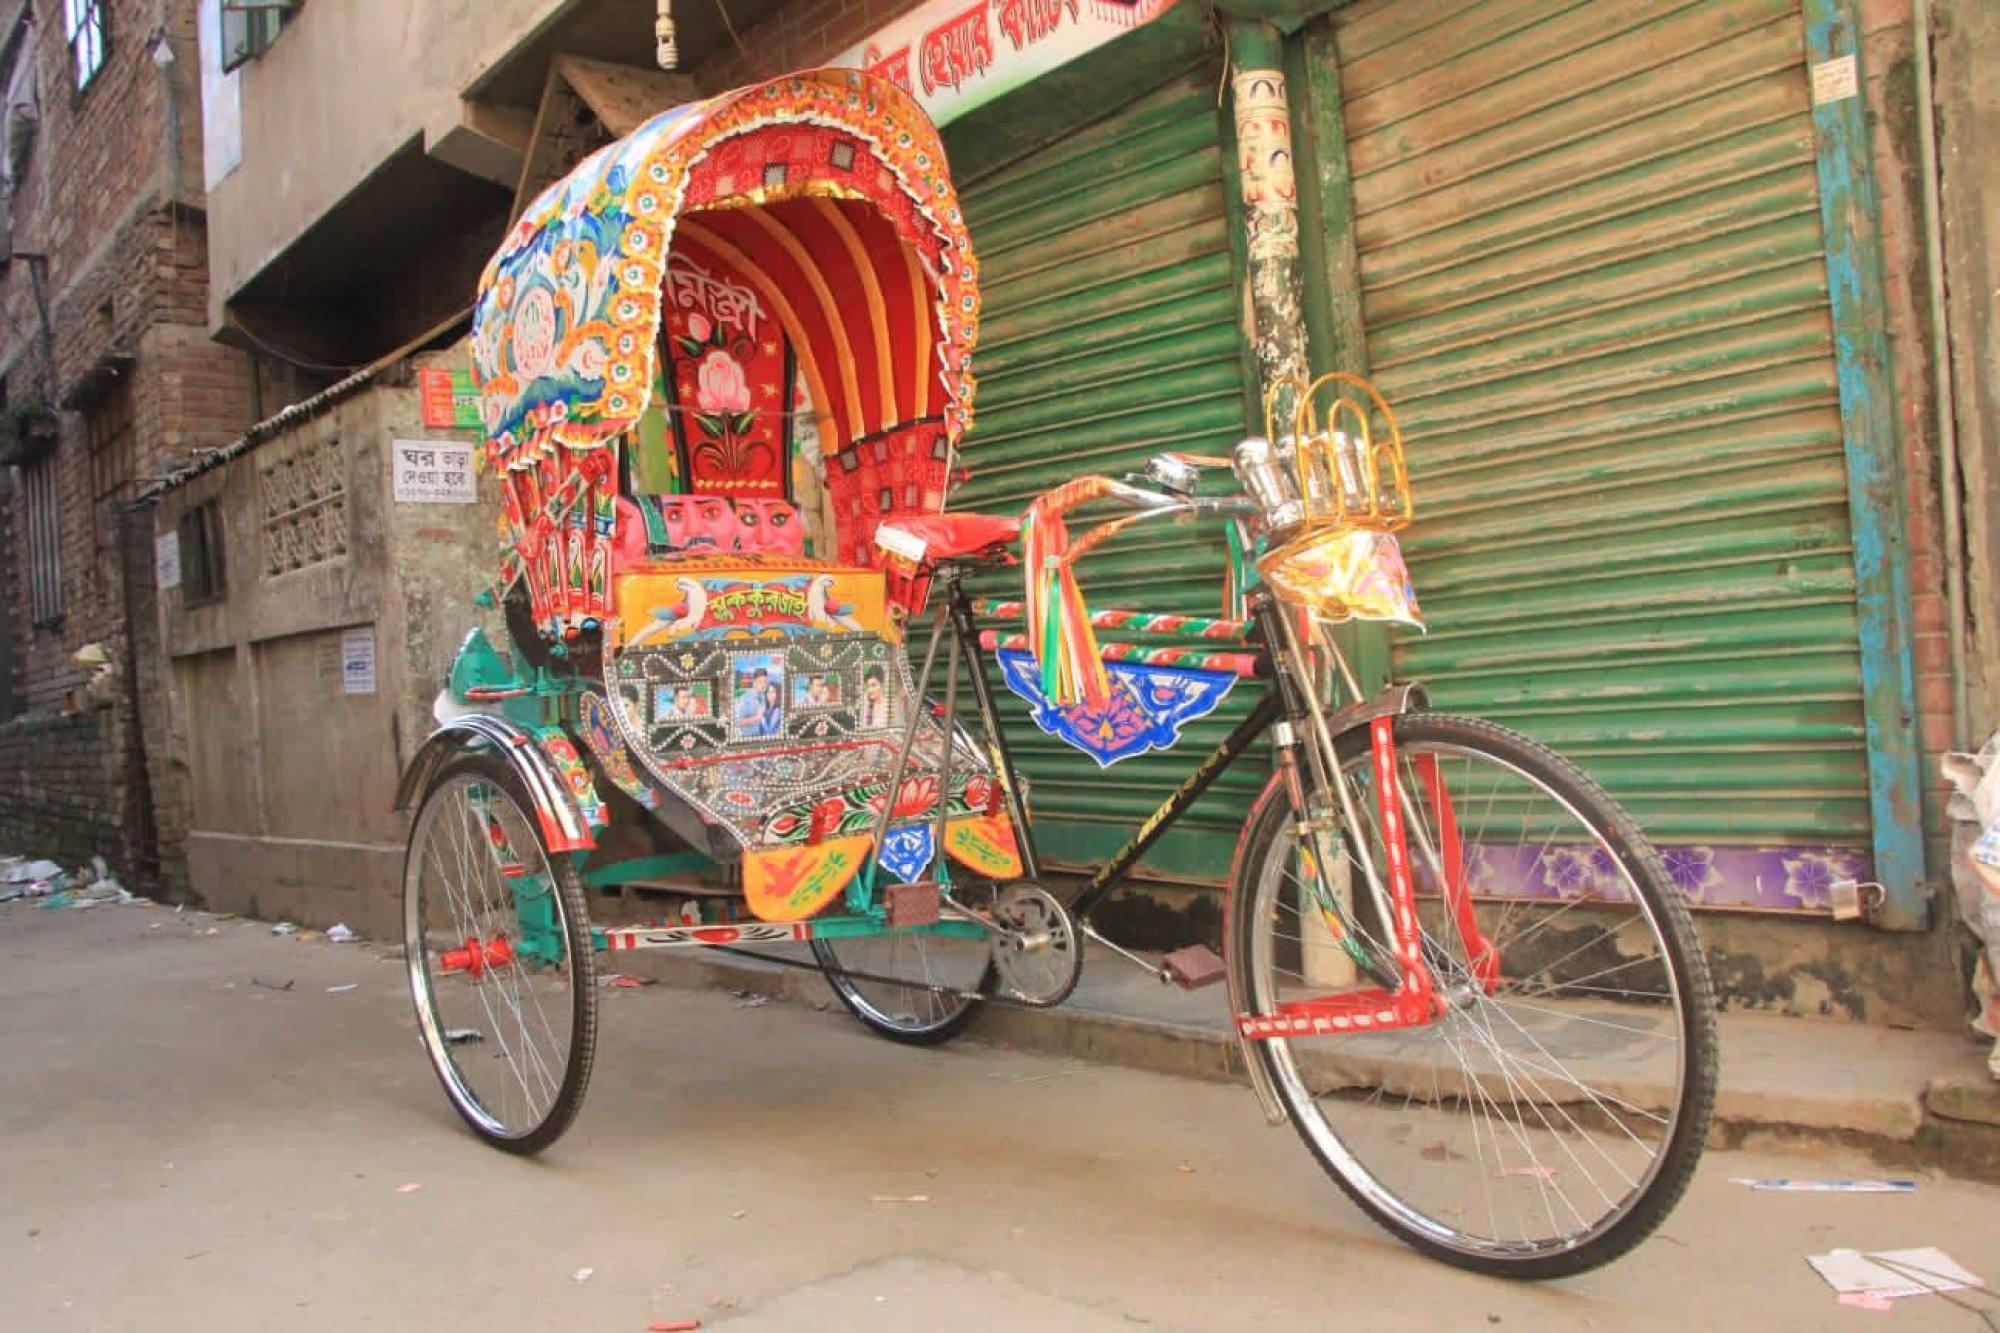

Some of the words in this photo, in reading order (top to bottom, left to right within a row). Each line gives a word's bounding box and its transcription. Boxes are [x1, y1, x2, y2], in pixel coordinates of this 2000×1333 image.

[920, 0, 994, 96] হেয়ার
[401, 448, 435, 467] ঘর
[402, 469, 438, 485] দেওয়া
[443, 470, 465, 485] হবে
